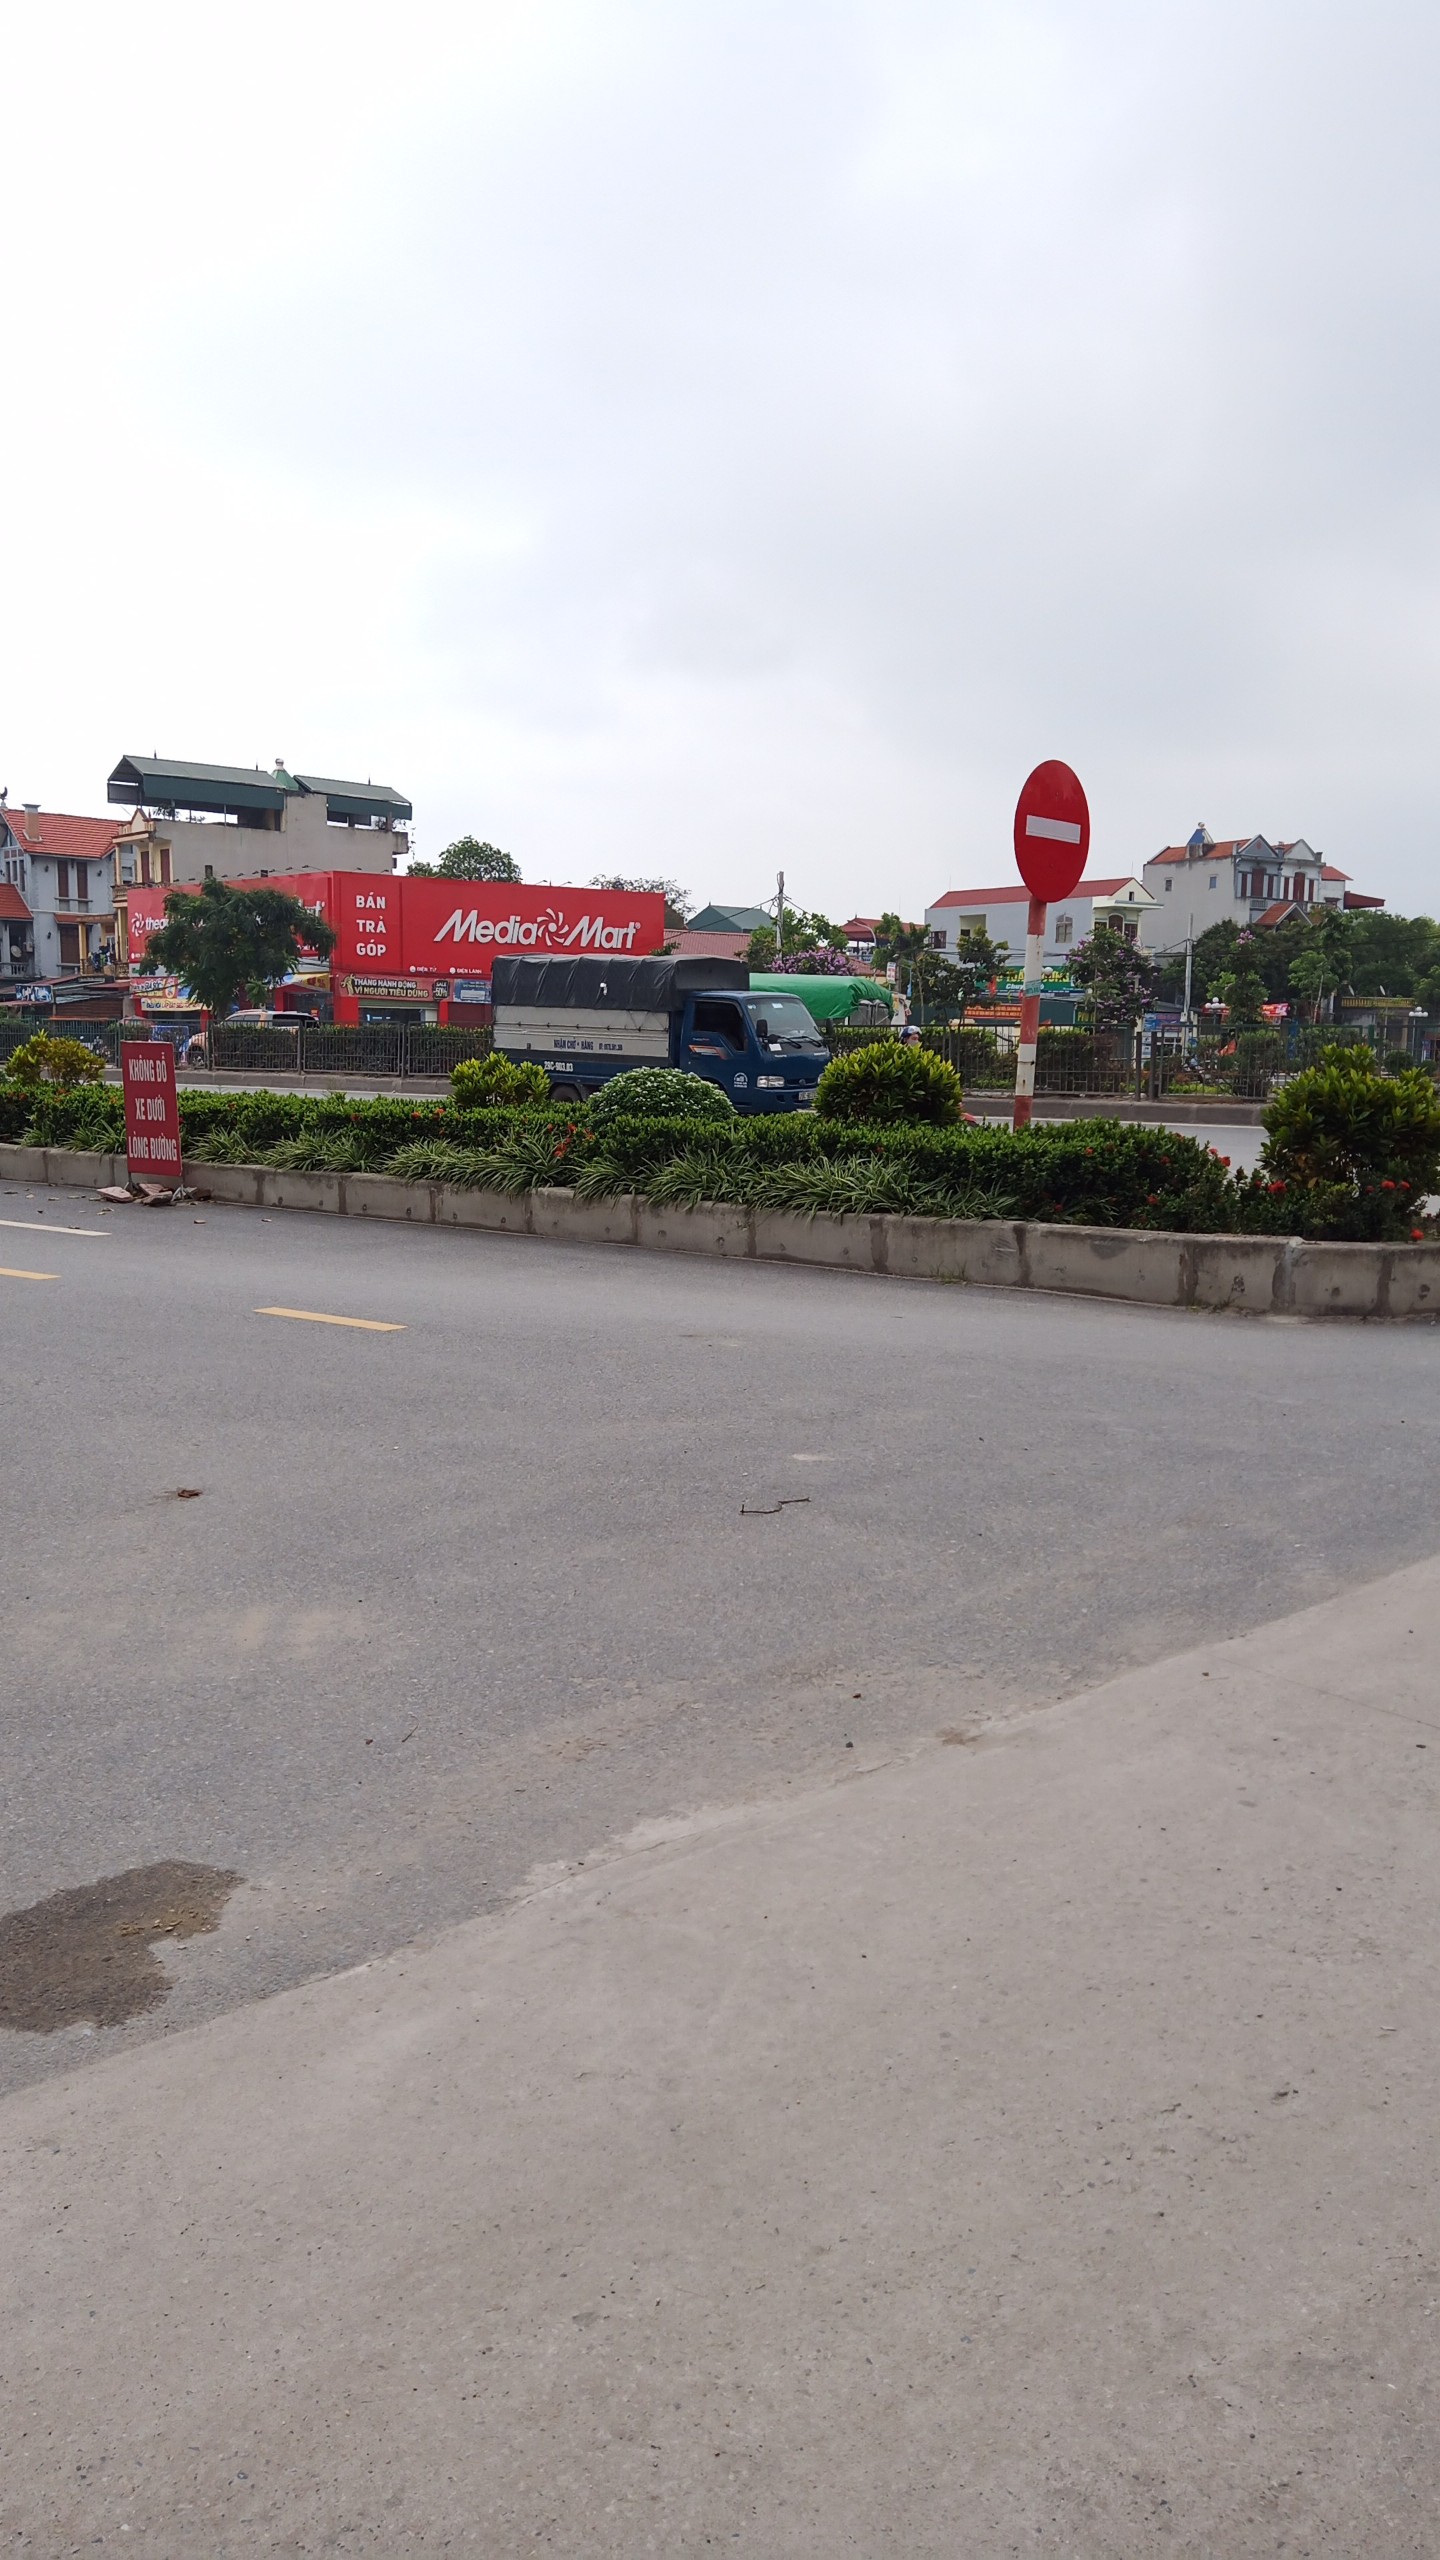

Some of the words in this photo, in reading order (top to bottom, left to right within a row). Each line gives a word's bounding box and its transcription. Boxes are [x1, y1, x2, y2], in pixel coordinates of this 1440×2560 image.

[356, 892, 386, 909] BÁN
[356, 915, 387, 933] TRẢ
[433, 909, 537, 945] Media
[563, 915, 636, 949] Mart
[356, 939, 387, 957] GÓP
[354, 977, 377, 987] THÁNG
[378, 978, 397, 988] HÀNH
[397, 979, 416, 989] ĐỘNG
[354, 986, 363, 995] VÌ
[363, 986, 388, 996] NGƯỜI
[388, 986, 407, 997] TIÊU
[407, 987, 428, 998] DÙNG
[128, 1054, 156, 1082] KHÔNG
[156, 1052, 168, 1083] ĐỖ
[135, 1098, 146, 1120] XE
[147, 1094, 166, 1121] DƯỚI
[128, 1131, 149, 1159] LÒNG
[149, 1132, 178, 1161] ĐƯỜNG
